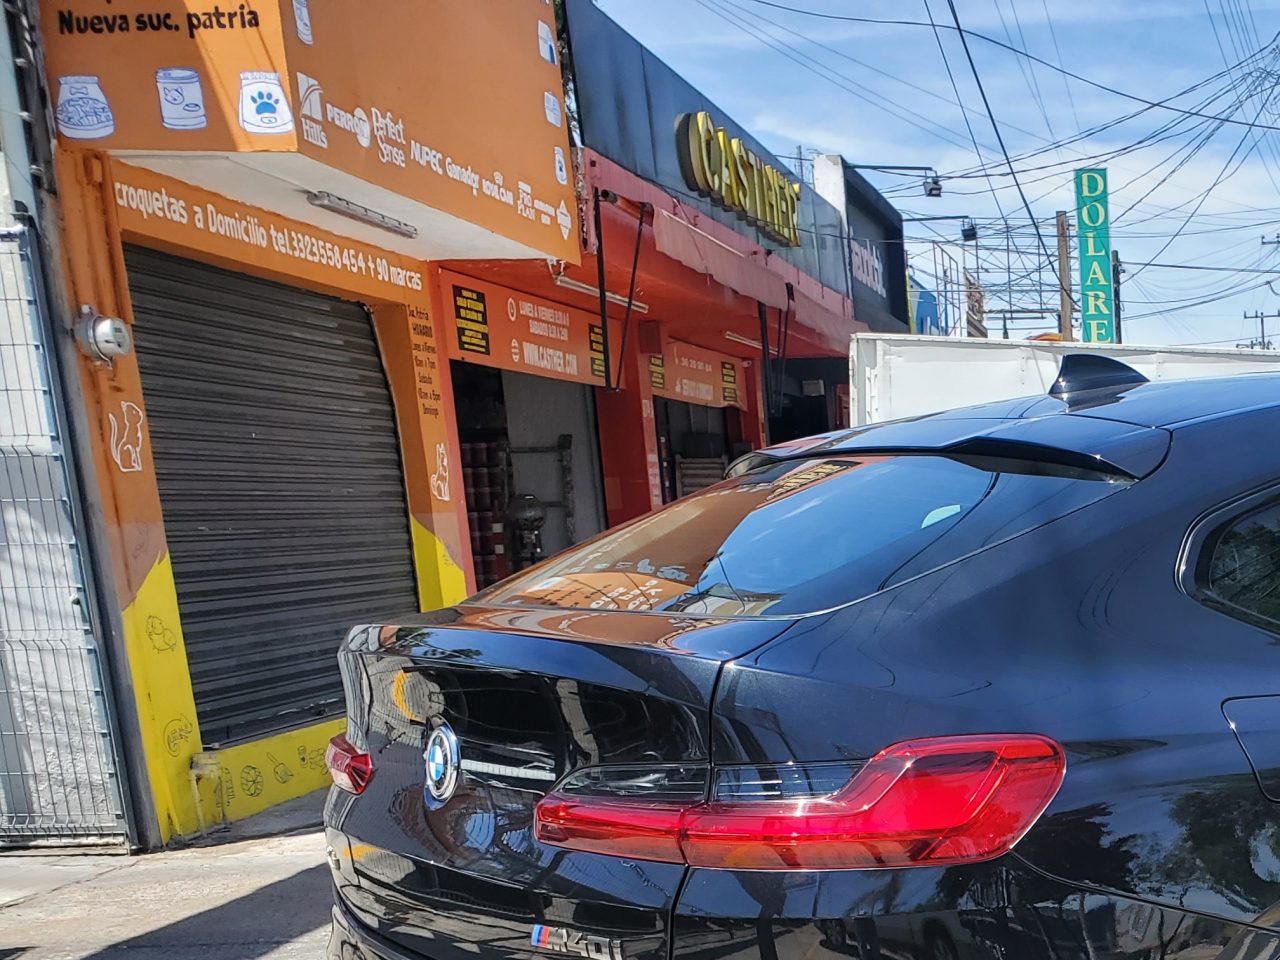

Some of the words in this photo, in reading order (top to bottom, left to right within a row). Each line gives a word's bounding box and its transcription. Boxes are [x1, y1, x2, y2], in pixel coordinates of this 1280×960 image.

[58, 9, 129, 34] Nueva
[135, 11, 180, 32] suc.
[186, 4, 260, 38] patria
[371, 106, 406, 145] Perfect
[377, 132, 406, 168] Sense
[410, 139, 443, 176] NUPEC
[676, 111, 801, 248] CASTHER
[114, 181, 189, 225] croquetas
[192, 205, 205, 230] a
[206, 202, 268, 249] Domicilio
[376, 256, 390, 283] 90
[389, 264, 423, 292] marcas
